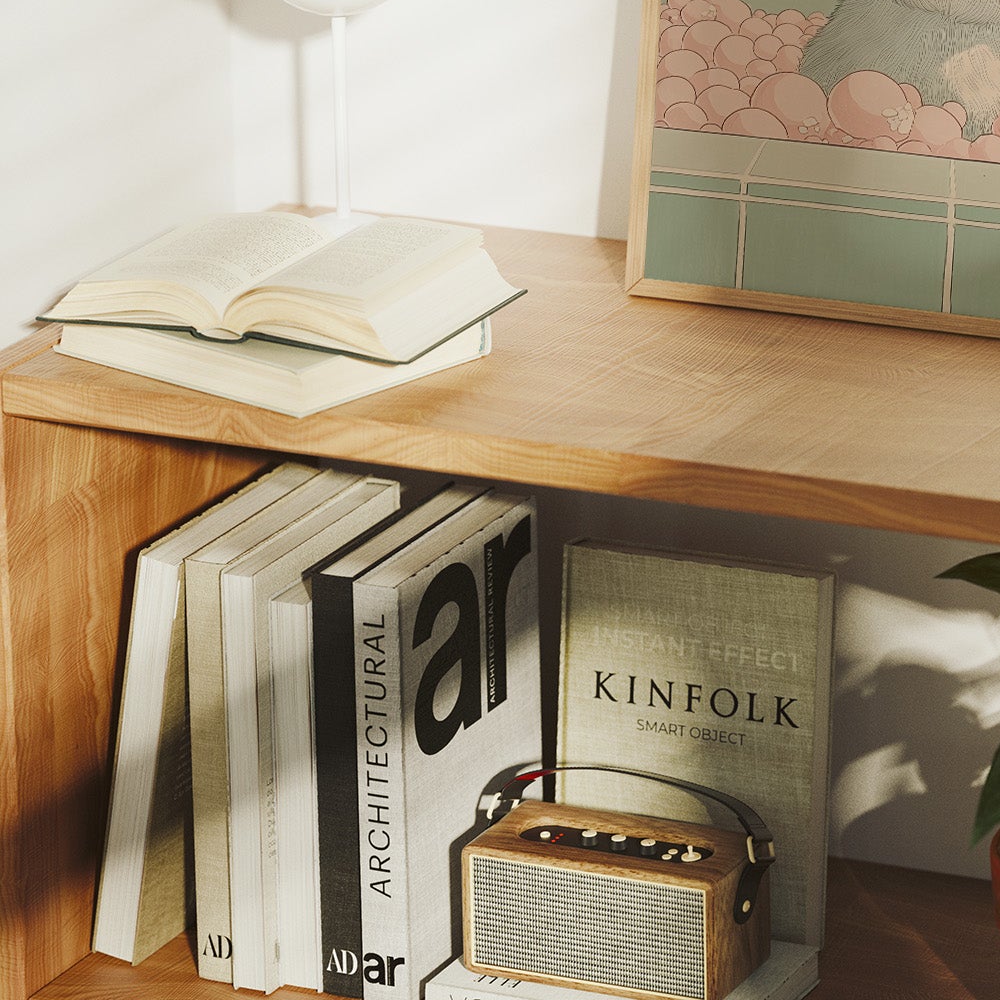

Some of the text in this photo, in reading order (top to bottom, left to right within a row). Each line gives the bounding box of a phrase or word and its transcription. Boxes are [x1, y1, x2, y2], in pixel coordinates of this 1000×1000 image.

[412, 513, 531, 756] ar
[488, 599, 496, 703] ARCHITECTURAL
[593, 670, 800, 729] KINFOLK
[636, 718, 747, 746] SMART OBJECT
[363, 614, 392, 898] ARCHITECTURAL
[203, 933, 233, 960] AD
[326, 948, 358, 976] AD
[363, 952, 405, 987] ar
